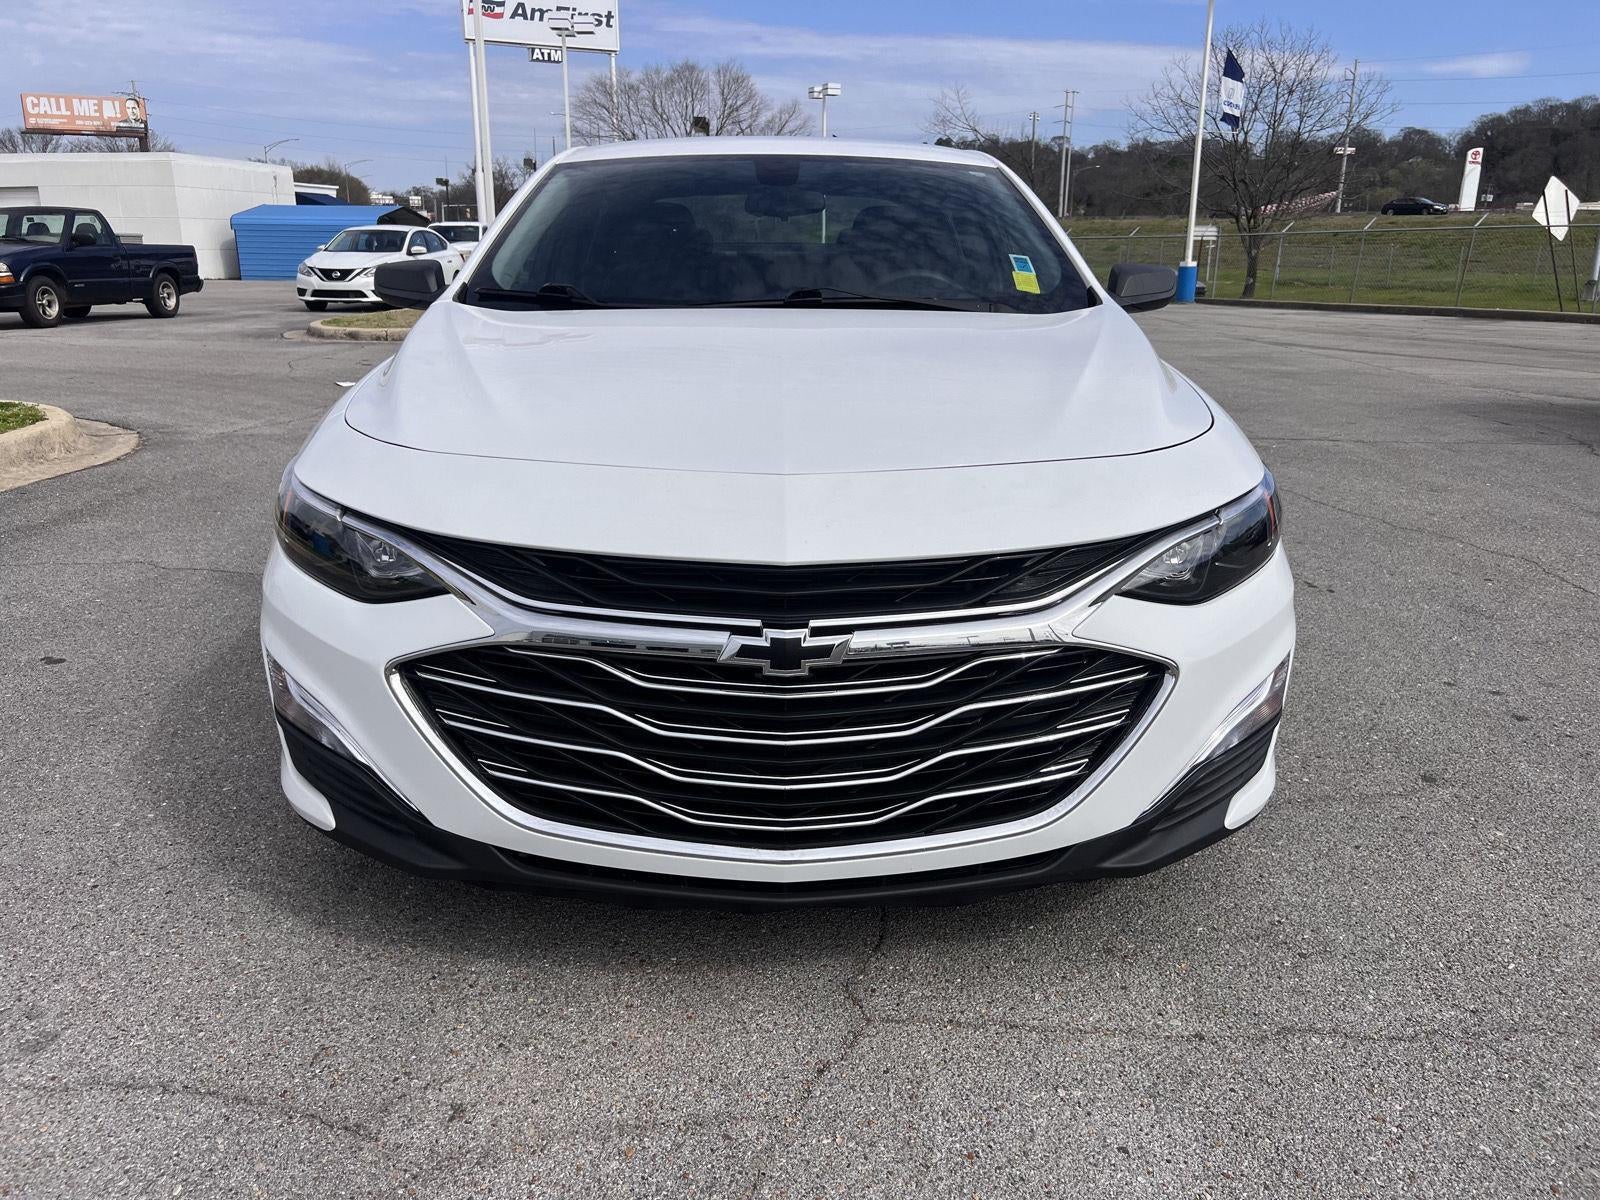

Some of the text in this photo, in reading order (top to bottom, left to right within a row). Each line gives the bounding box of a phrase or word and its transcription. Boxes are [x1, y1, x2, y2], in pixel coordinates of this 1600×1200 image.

[532, 48, 562, 62] ATM
[26, 96, 71, 116] CALL
[72, 98, 100, 117] ME
